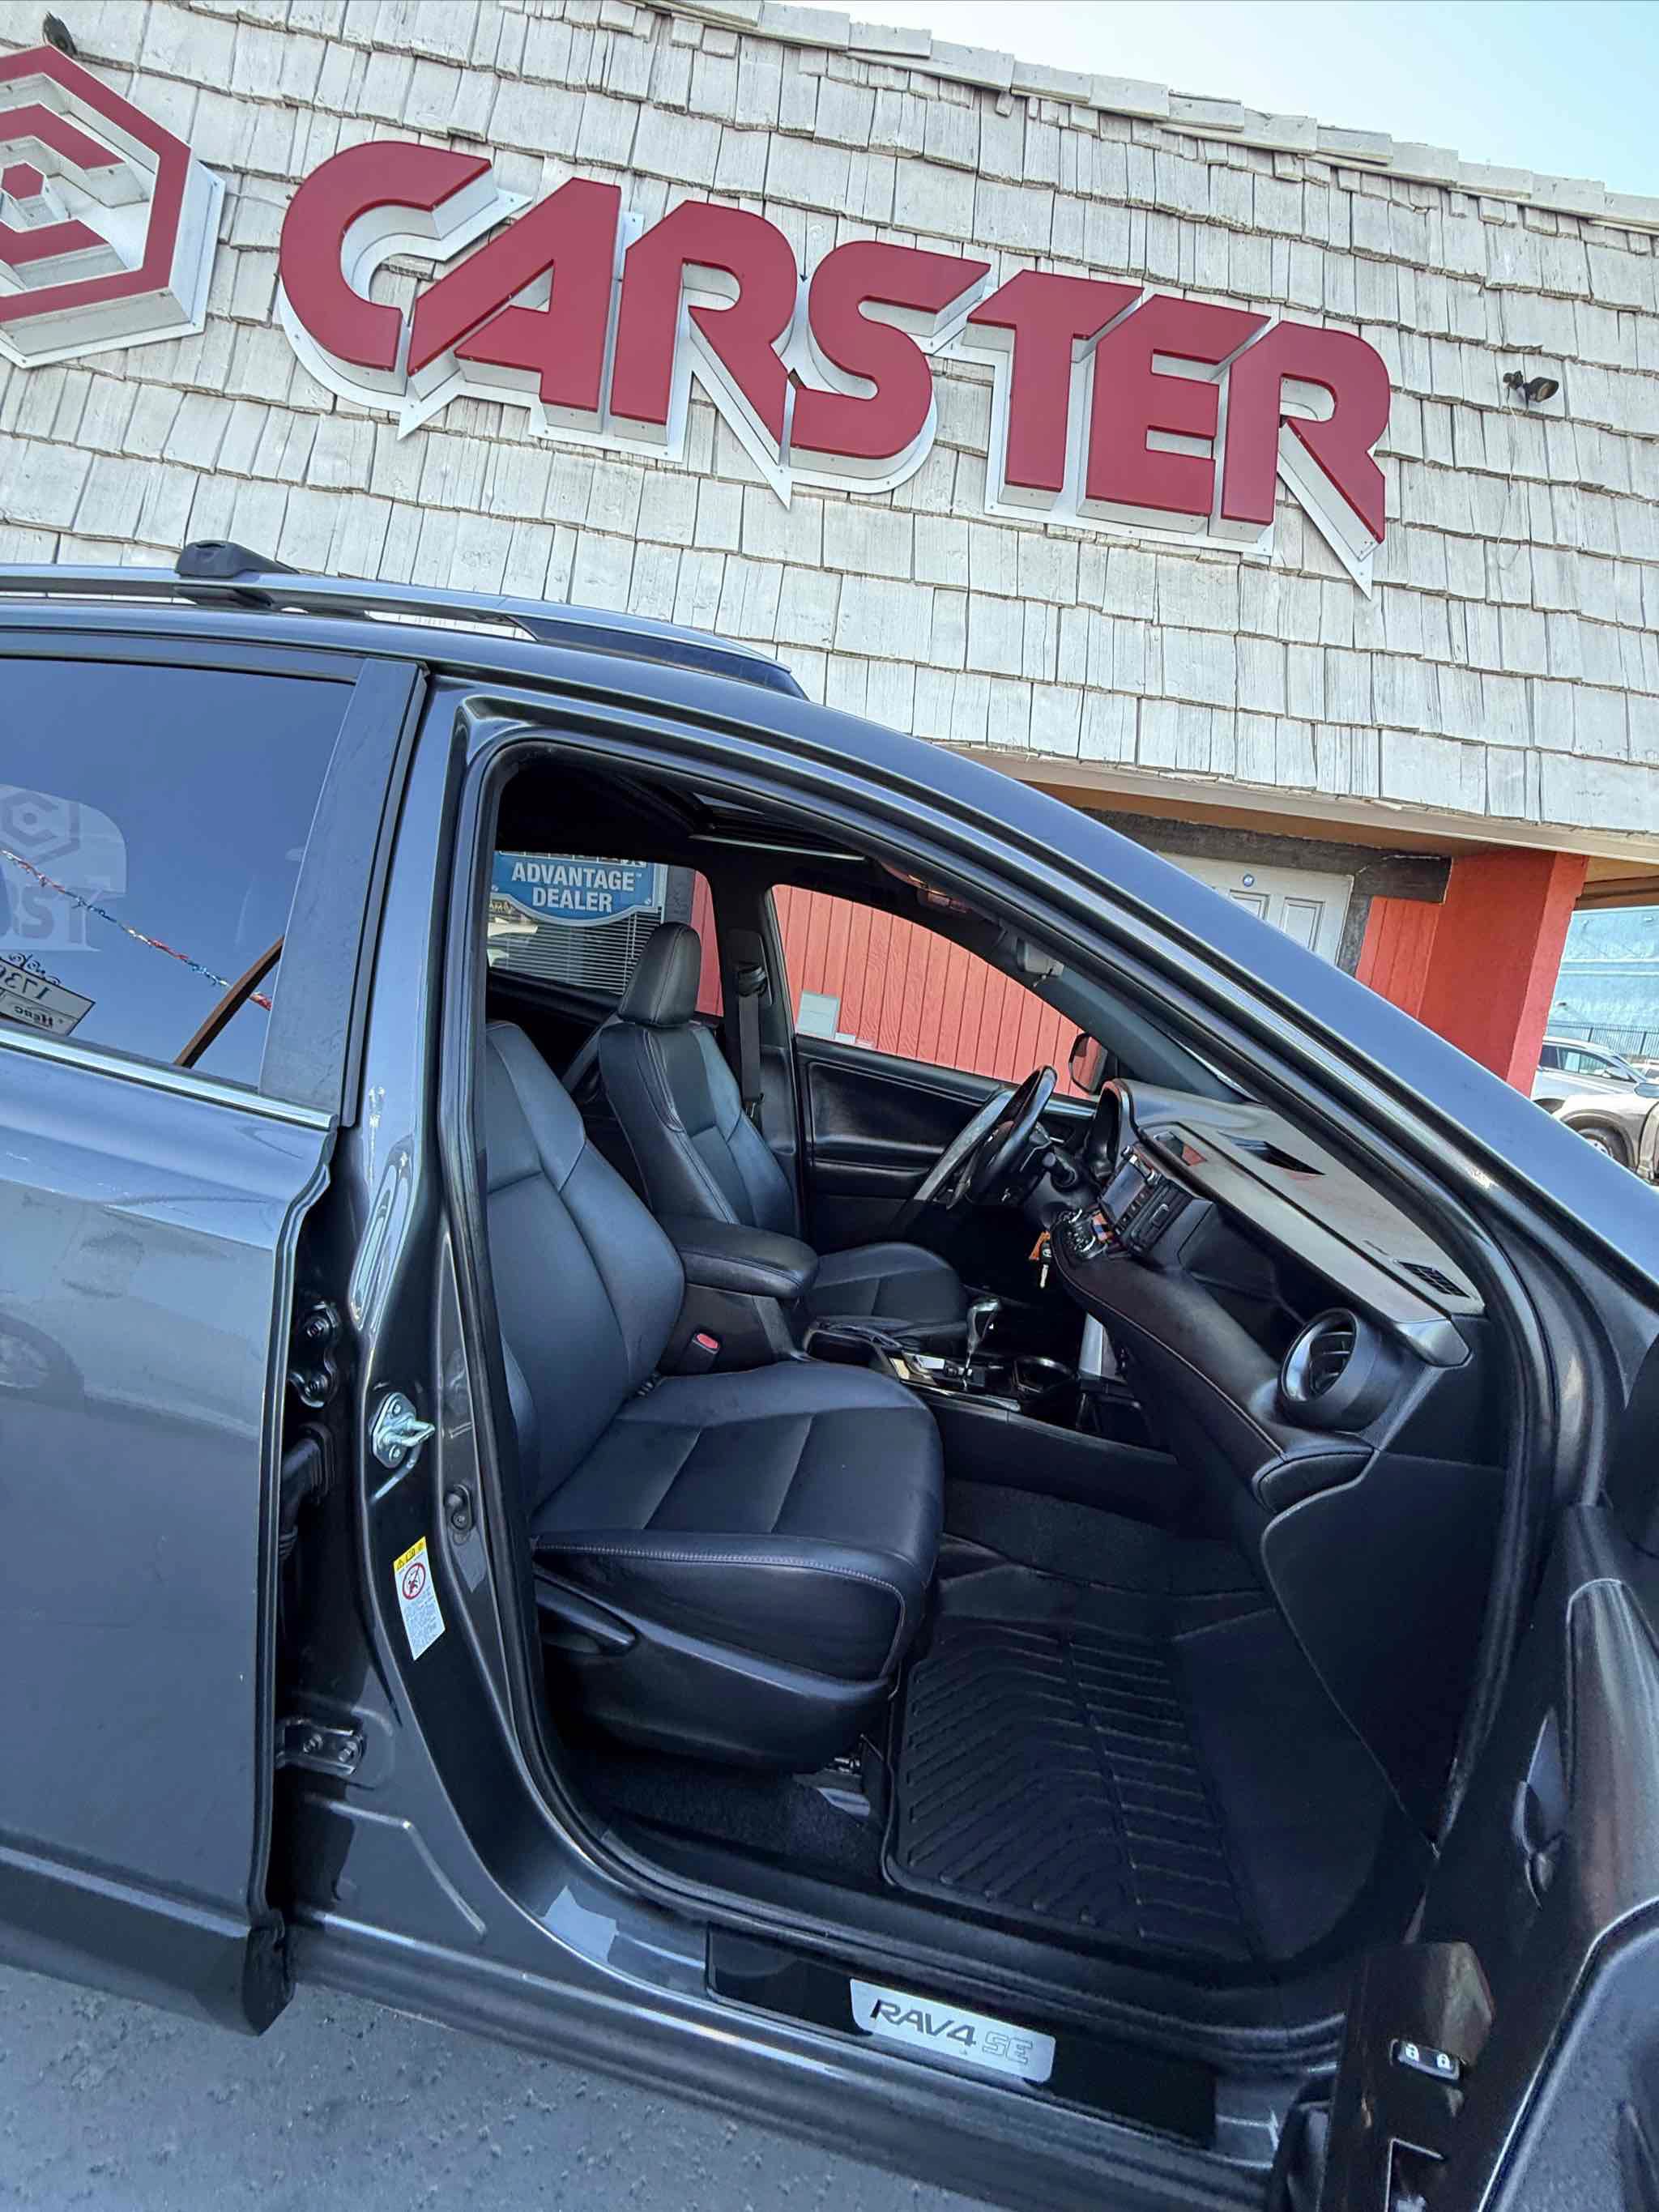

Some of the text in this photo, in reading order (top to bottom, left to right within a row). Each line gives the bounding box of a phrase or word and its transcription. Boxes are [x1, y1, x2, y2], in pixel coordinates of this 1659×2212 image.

[278, 139, 1392, 551] CARSTER
[511, 861, 636, 892] ADVANTAGE
[531, 886, 613, 913] DEALER
[870, 1998, 1033, 2065] RAV4 SE
